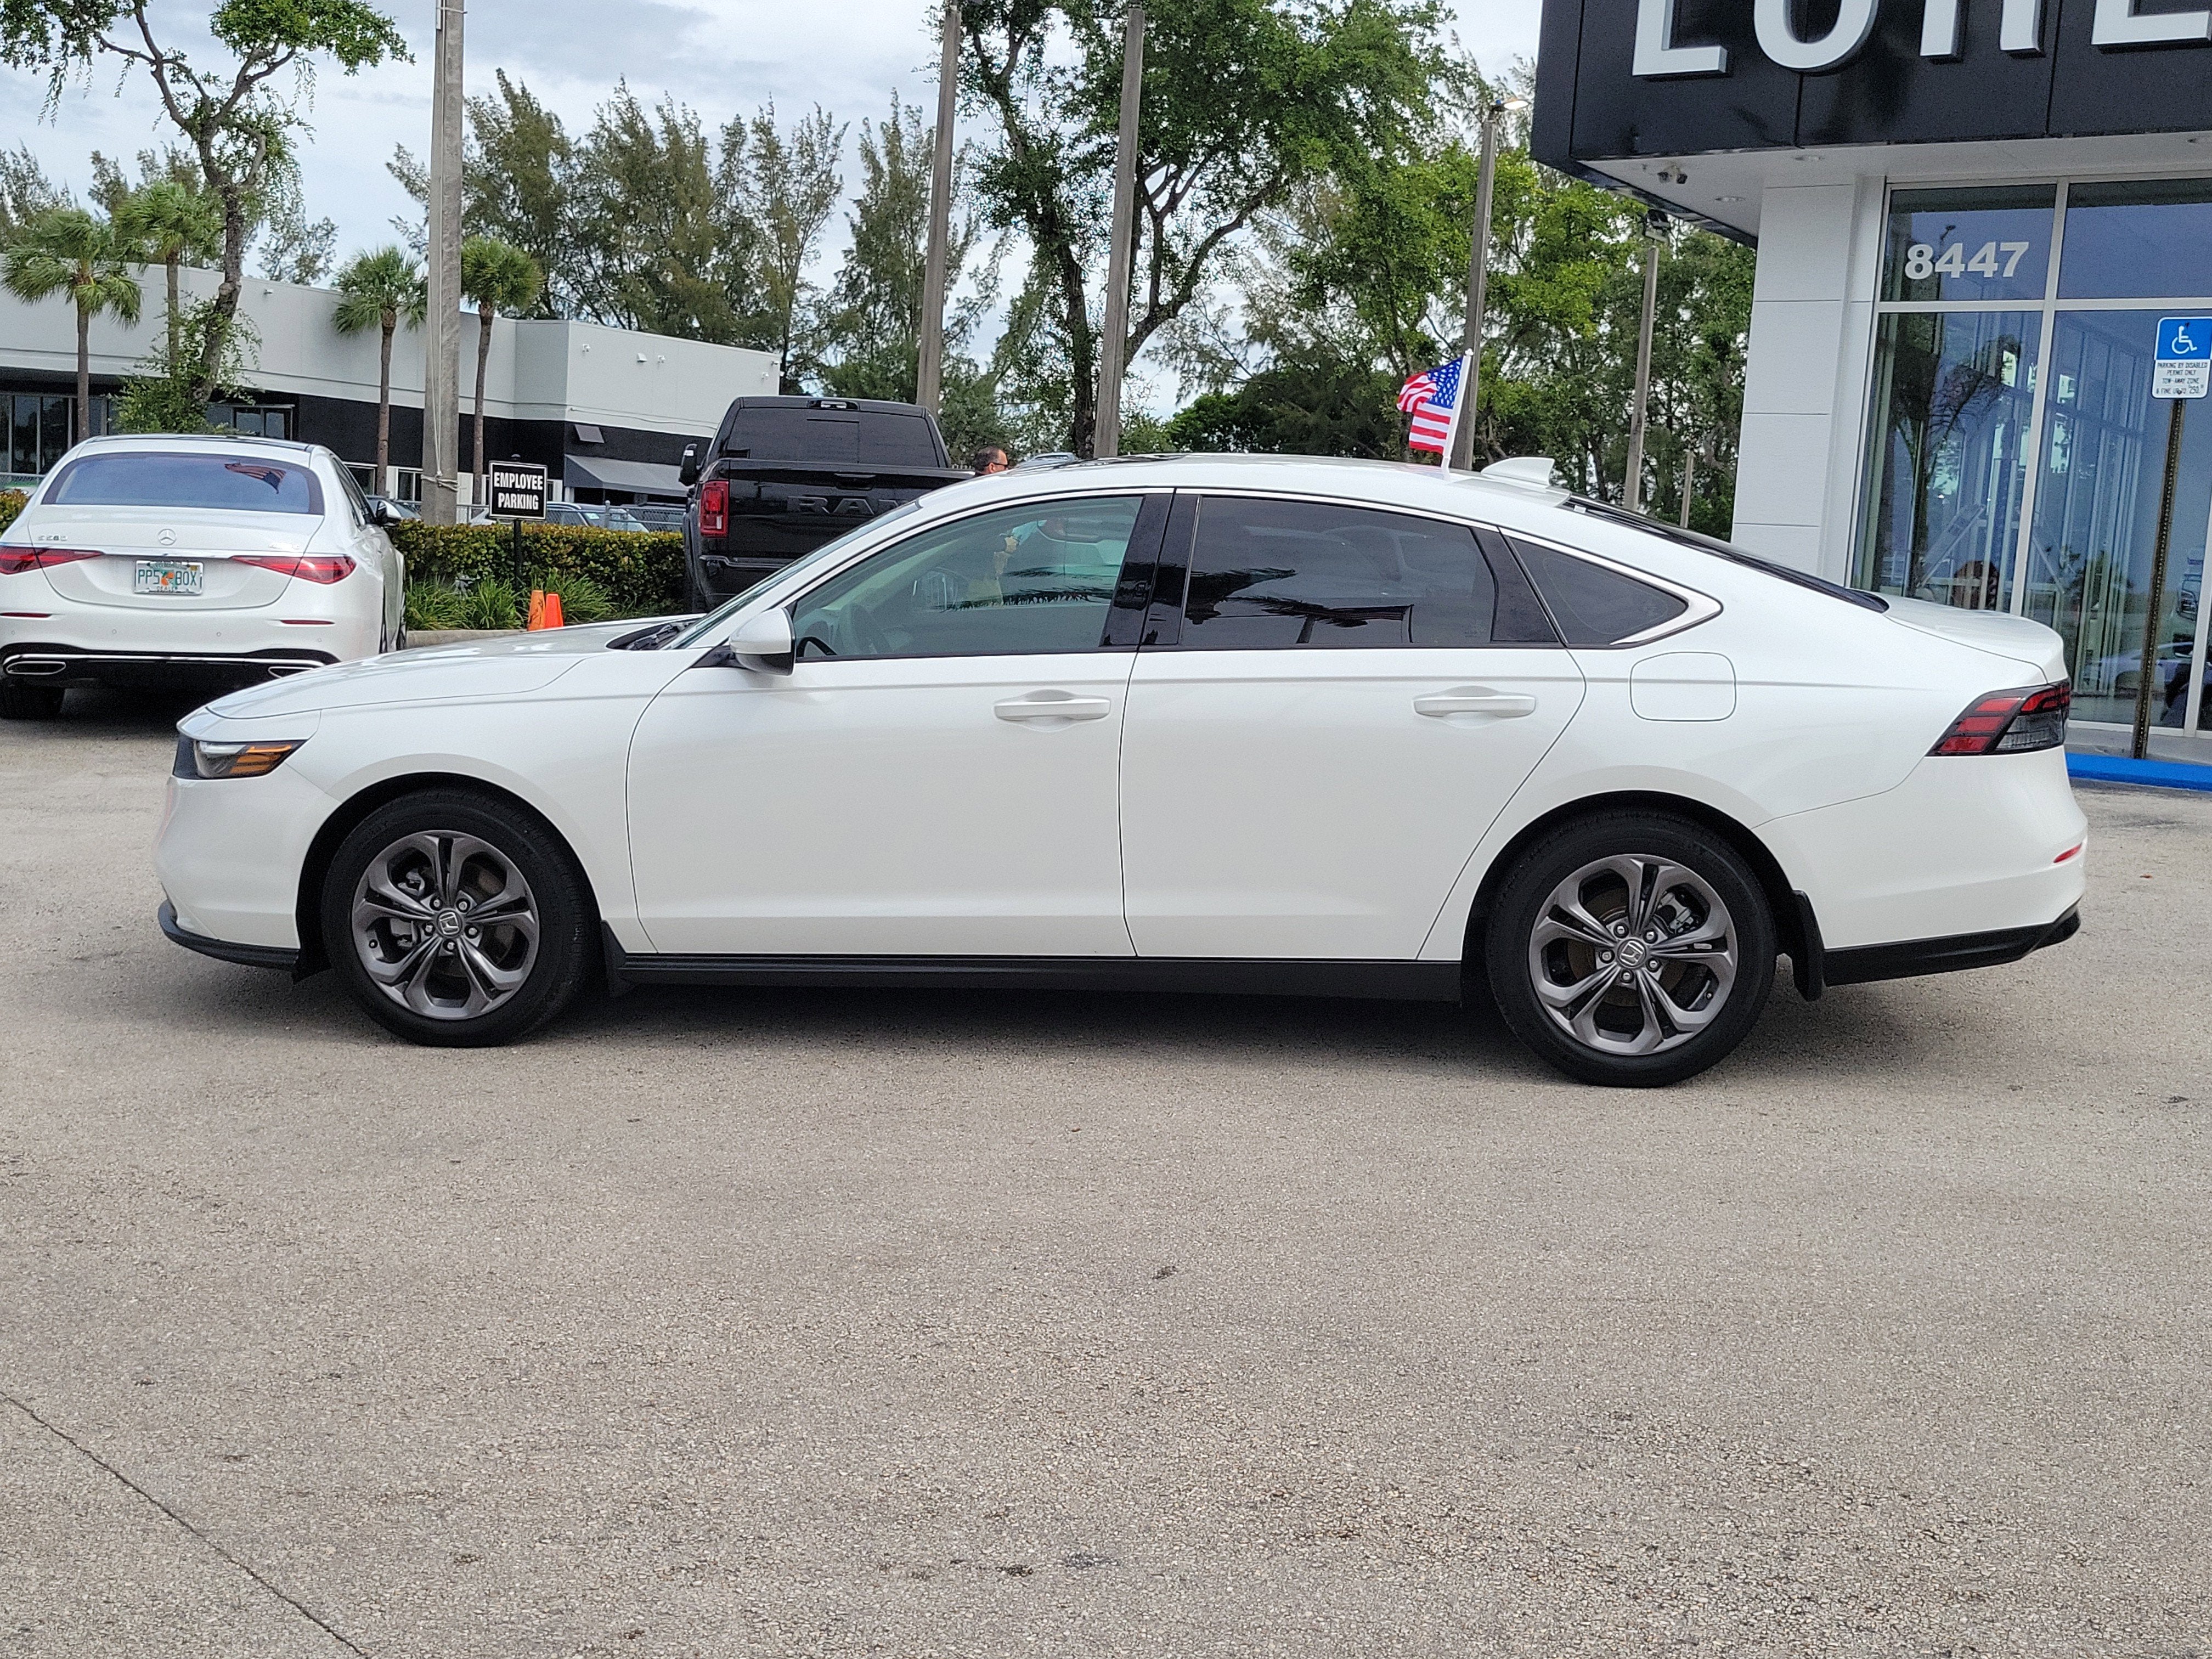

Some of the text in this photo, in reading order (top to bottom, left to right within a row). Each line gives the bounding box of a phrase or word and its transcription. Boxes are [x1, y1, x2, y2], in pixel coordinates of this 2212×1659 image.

[1905, 242, 2029, 279] 8447
[494, 472, 543, 490] EMPLOYEE
[498, 492, 539, 510] PARKING
